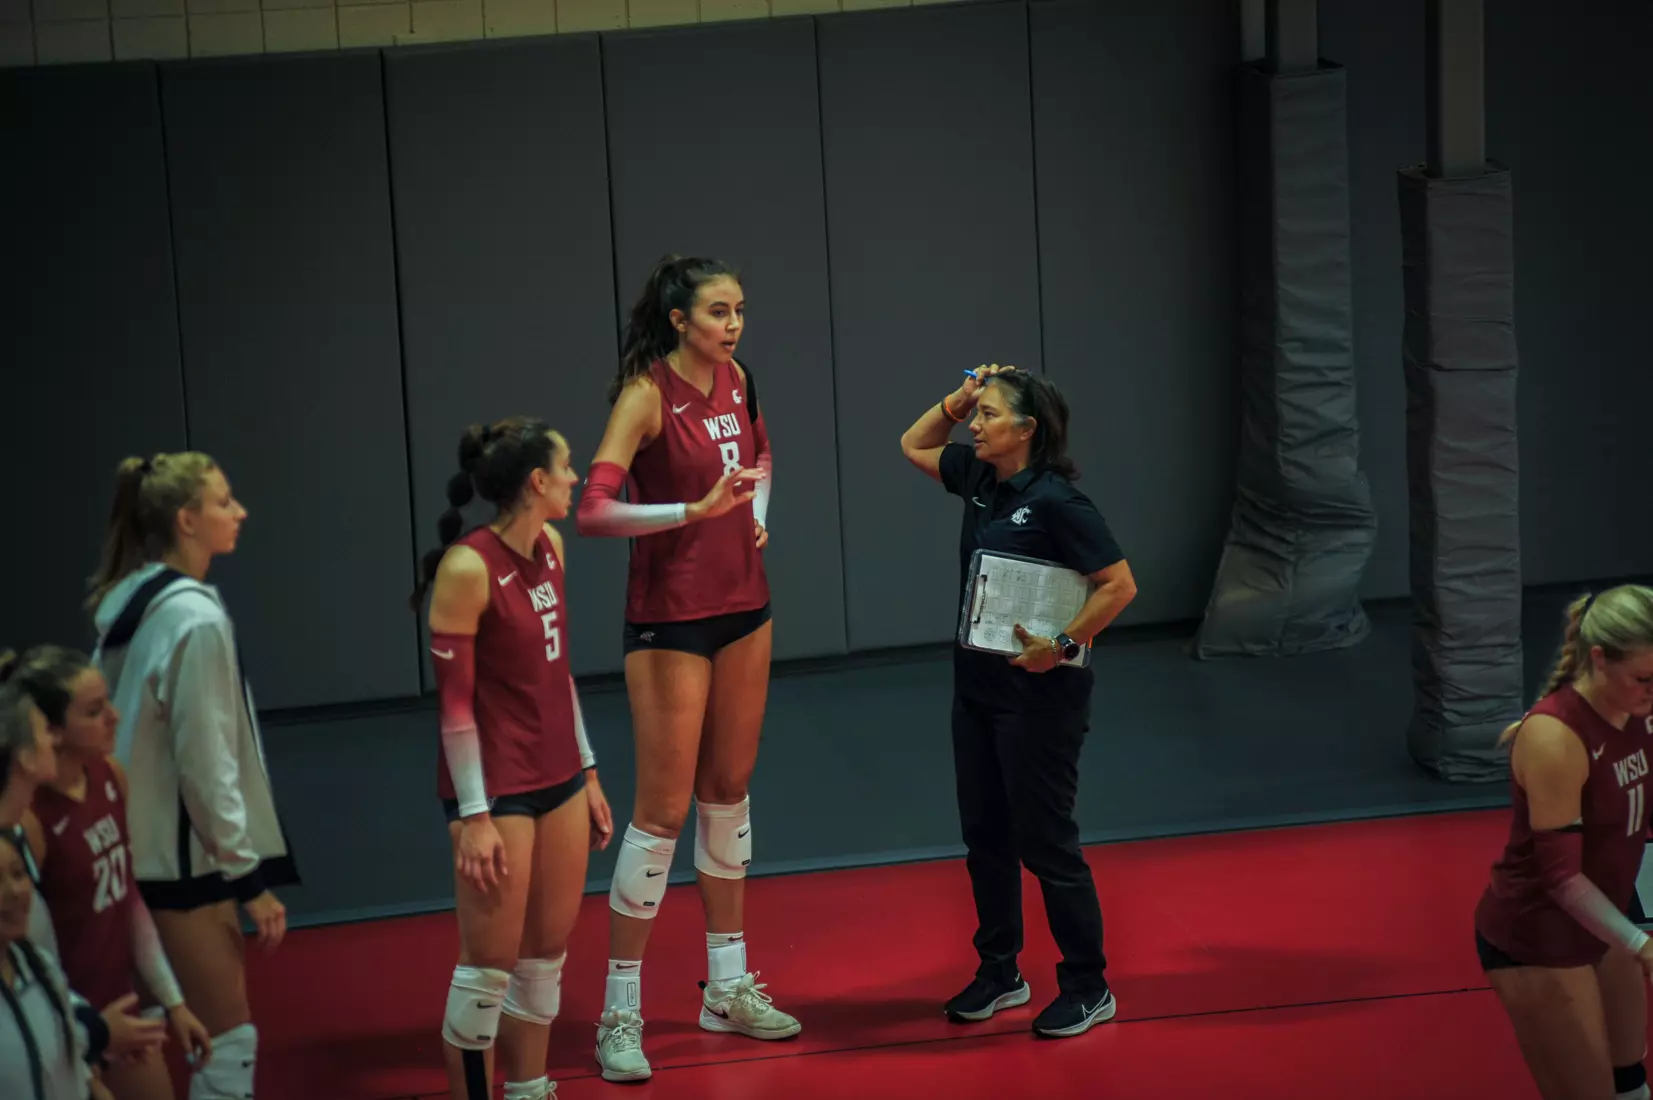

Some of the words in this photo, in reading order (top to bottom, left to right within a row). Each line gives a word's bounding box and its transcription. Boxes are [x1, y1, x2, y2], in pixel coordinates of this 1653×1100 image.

[702, 412, 741, 441] WSU
[718, 441, 740, 478] 8
[528, 580, 558, 613] WSU
[541, 611, 561, 662] 5
[1612, 748, 1649, 787] WSU
[1627, 782, 1644, 837] 11
[83, 812, 120, 856] WSU
[92, 843, 128, 914] 20
